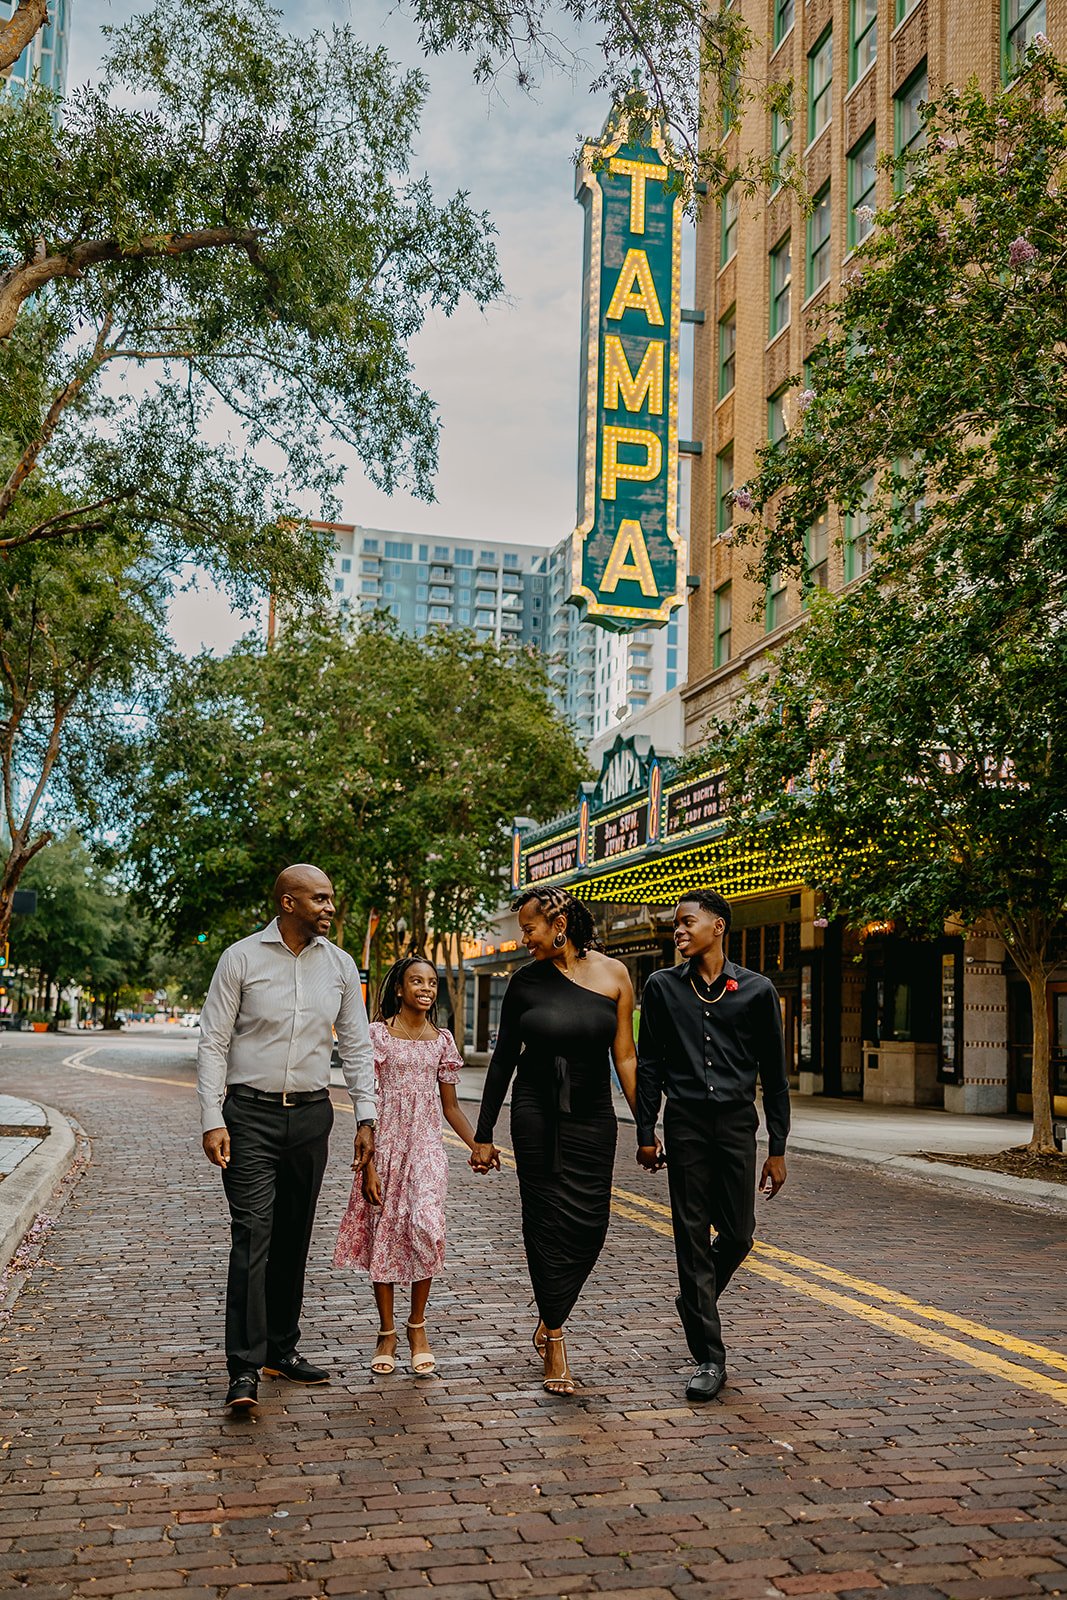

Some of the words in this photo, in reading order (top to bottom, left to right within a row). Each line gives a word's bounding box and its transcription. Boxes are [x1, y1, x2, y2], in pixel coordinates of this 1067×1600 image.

[598, 157, 668, 599] TAMPA
[600, 750, 641, 804] TAMPA
[703, 802, 717, 818] FOR
[604, 834, 626, 857] JUNE
[627, 830, 638, 849] 23
